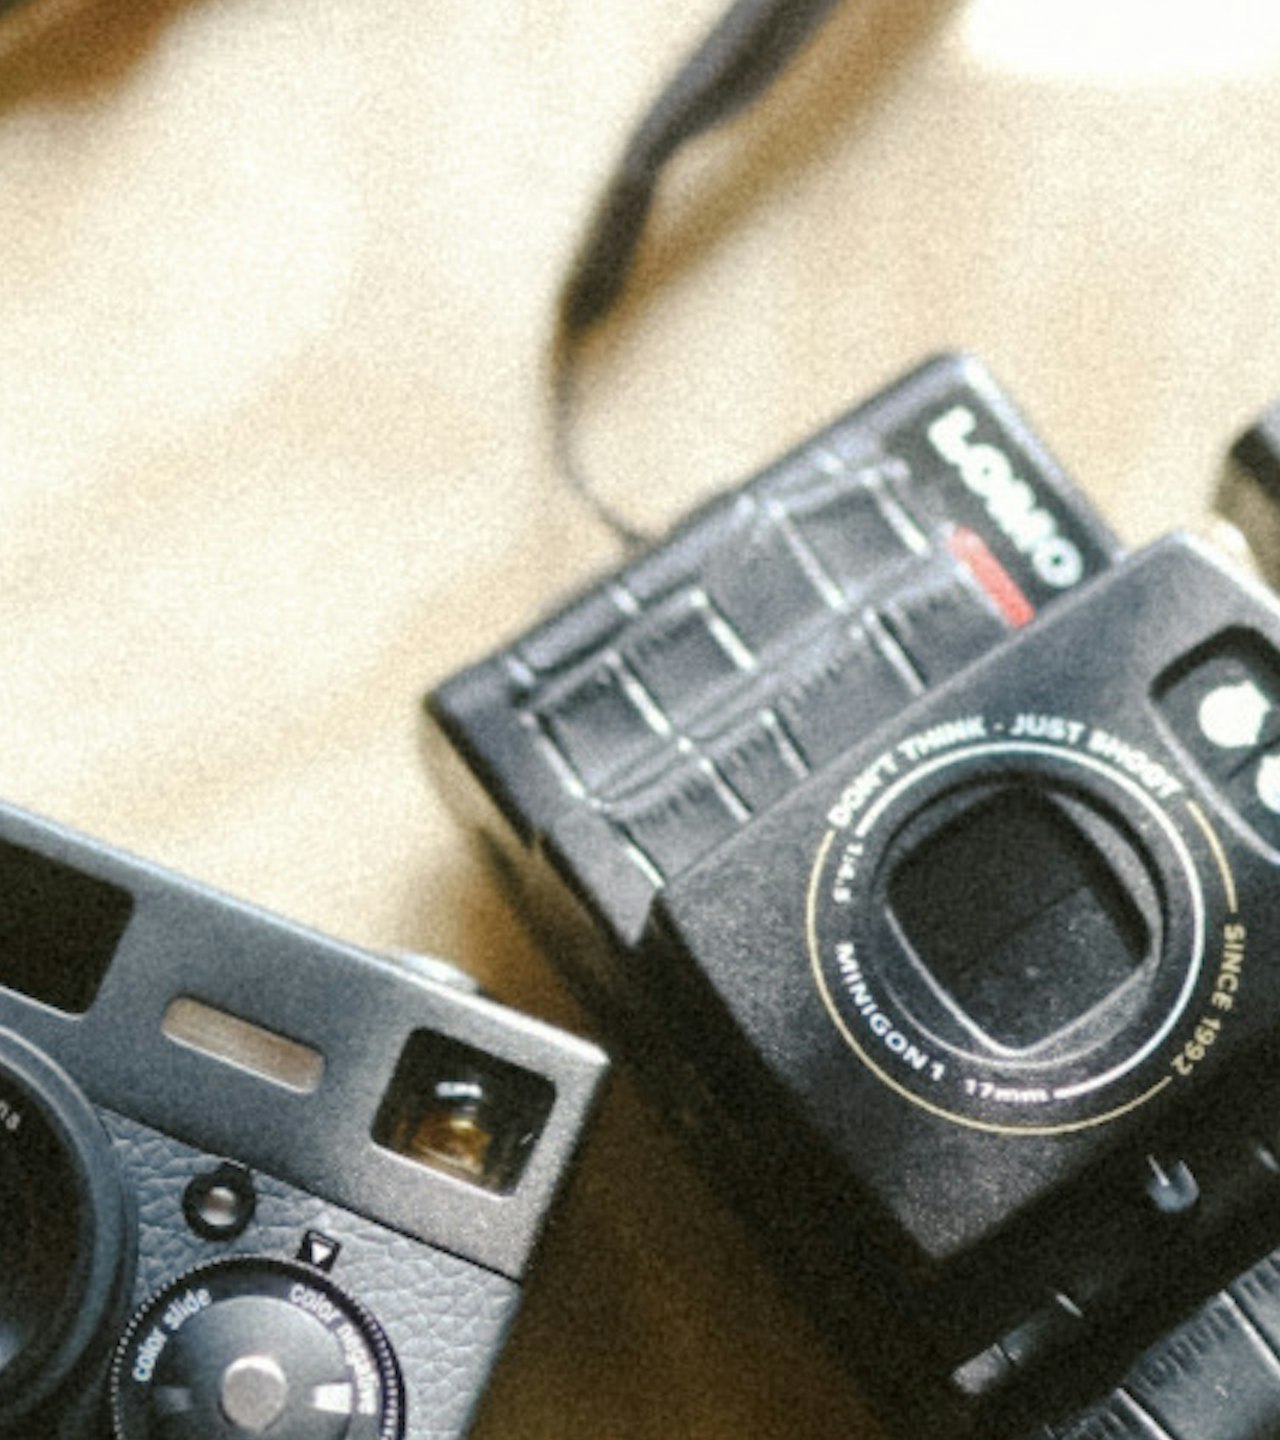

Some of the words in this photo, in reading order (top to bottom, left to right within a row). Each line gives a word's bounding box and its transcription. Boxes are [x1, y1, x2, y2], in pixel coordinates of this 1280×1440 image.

[927, 405, 1083, 588] LOMO
[896, 715, 988, 762] THINK
[1008, 713, 1086, 744] JUST
[1086, 730, 1186, 800] SHOOT
[834, 941, 929, 1070] MINIGON
[1211, 923, 1246, 1011] SINCE
[1171, 1017, 1221, 1076] 1992
[132, 1325, 168, 1382] color
[162, 1288, 212, 1331] slide
[290, 1282, 342, 1323] color
